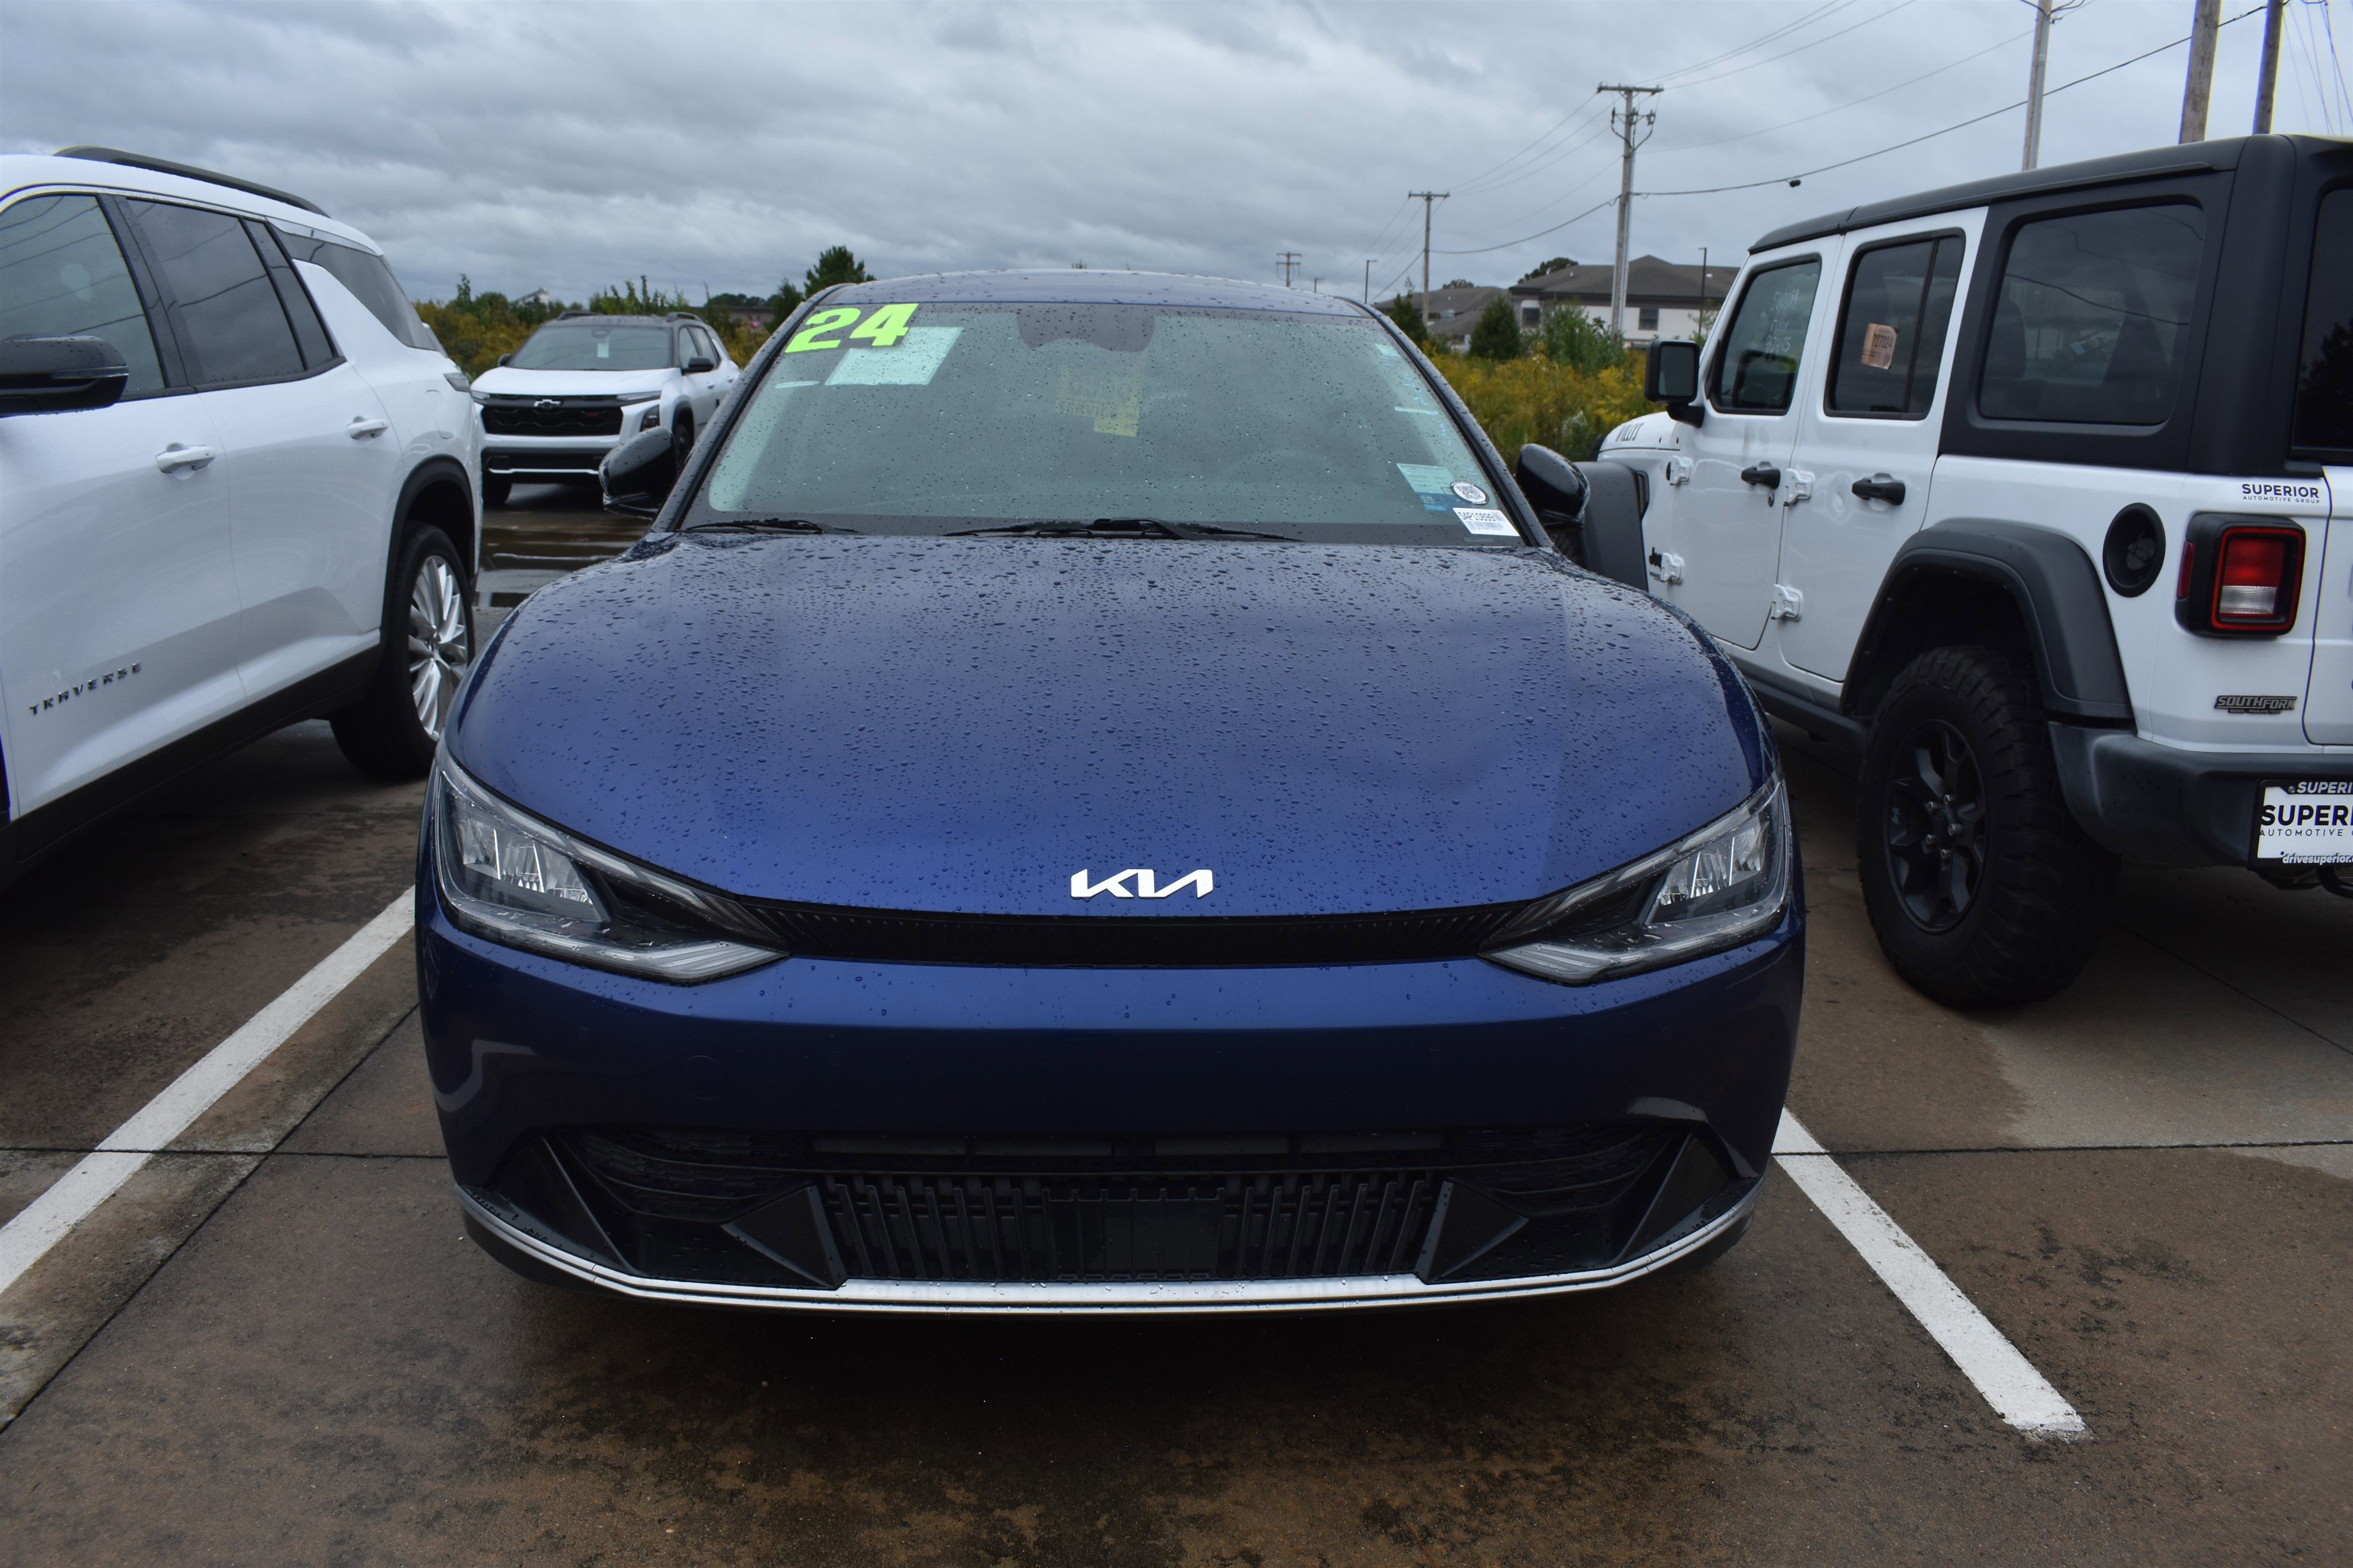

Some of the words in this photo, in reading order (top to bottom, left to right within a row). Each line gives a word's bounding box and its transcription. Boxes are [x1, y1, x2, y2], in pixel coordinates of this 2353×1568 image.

[784, 303, 919, 353] 24
[2242, 484, 2320, 498] SUPERIOR
[29, 662, 142, 716] TRAVERSE
[2216, 696, 2297, 710] SOUTHFORK
[2297, 782, 2353, 793] SUPERI
[2282, 853, 2353, 865] drivesuperior.
[1071, 868, 1214, 898] KIA
